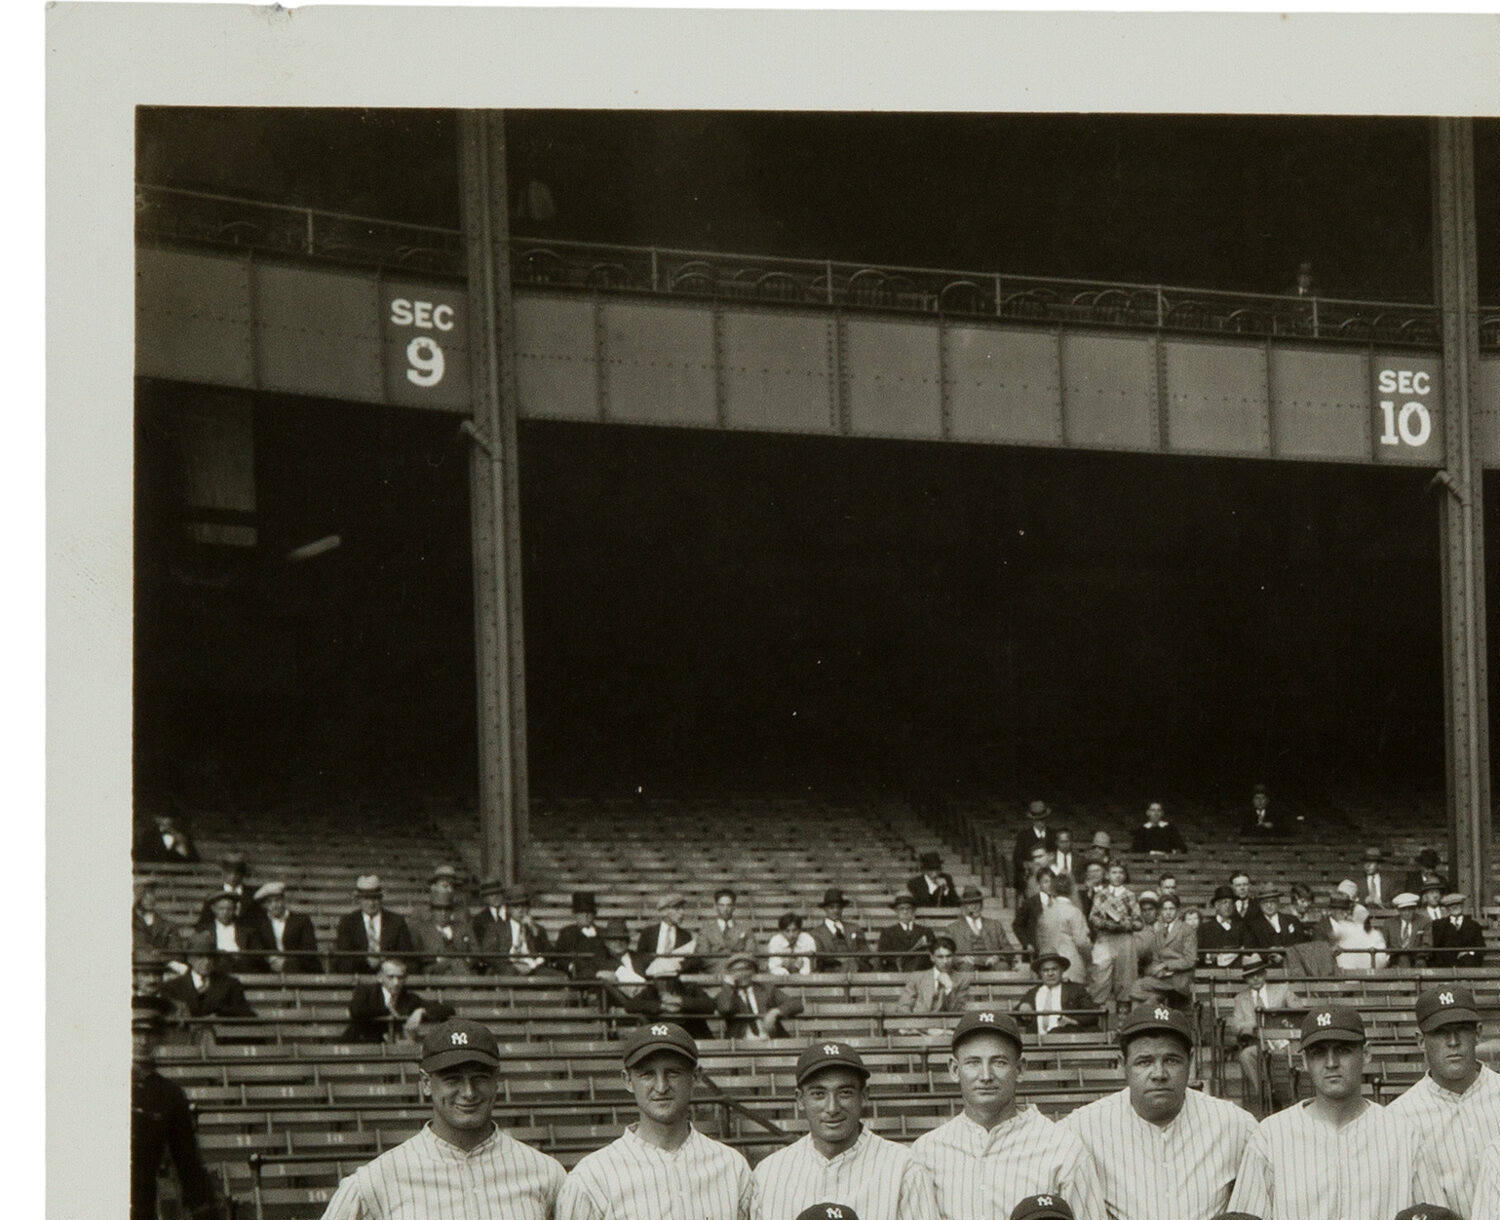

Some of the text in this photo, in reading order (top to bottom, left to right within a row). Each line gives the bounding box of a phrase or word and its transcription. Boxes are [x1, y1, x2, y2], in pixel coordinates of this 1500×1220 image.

[390, 298, 454, 331] SEC
[407, 336, 445, 387] 9
[1378, 369, 1430, 395] SEC
[1380, 401, 1431, 447] 10
